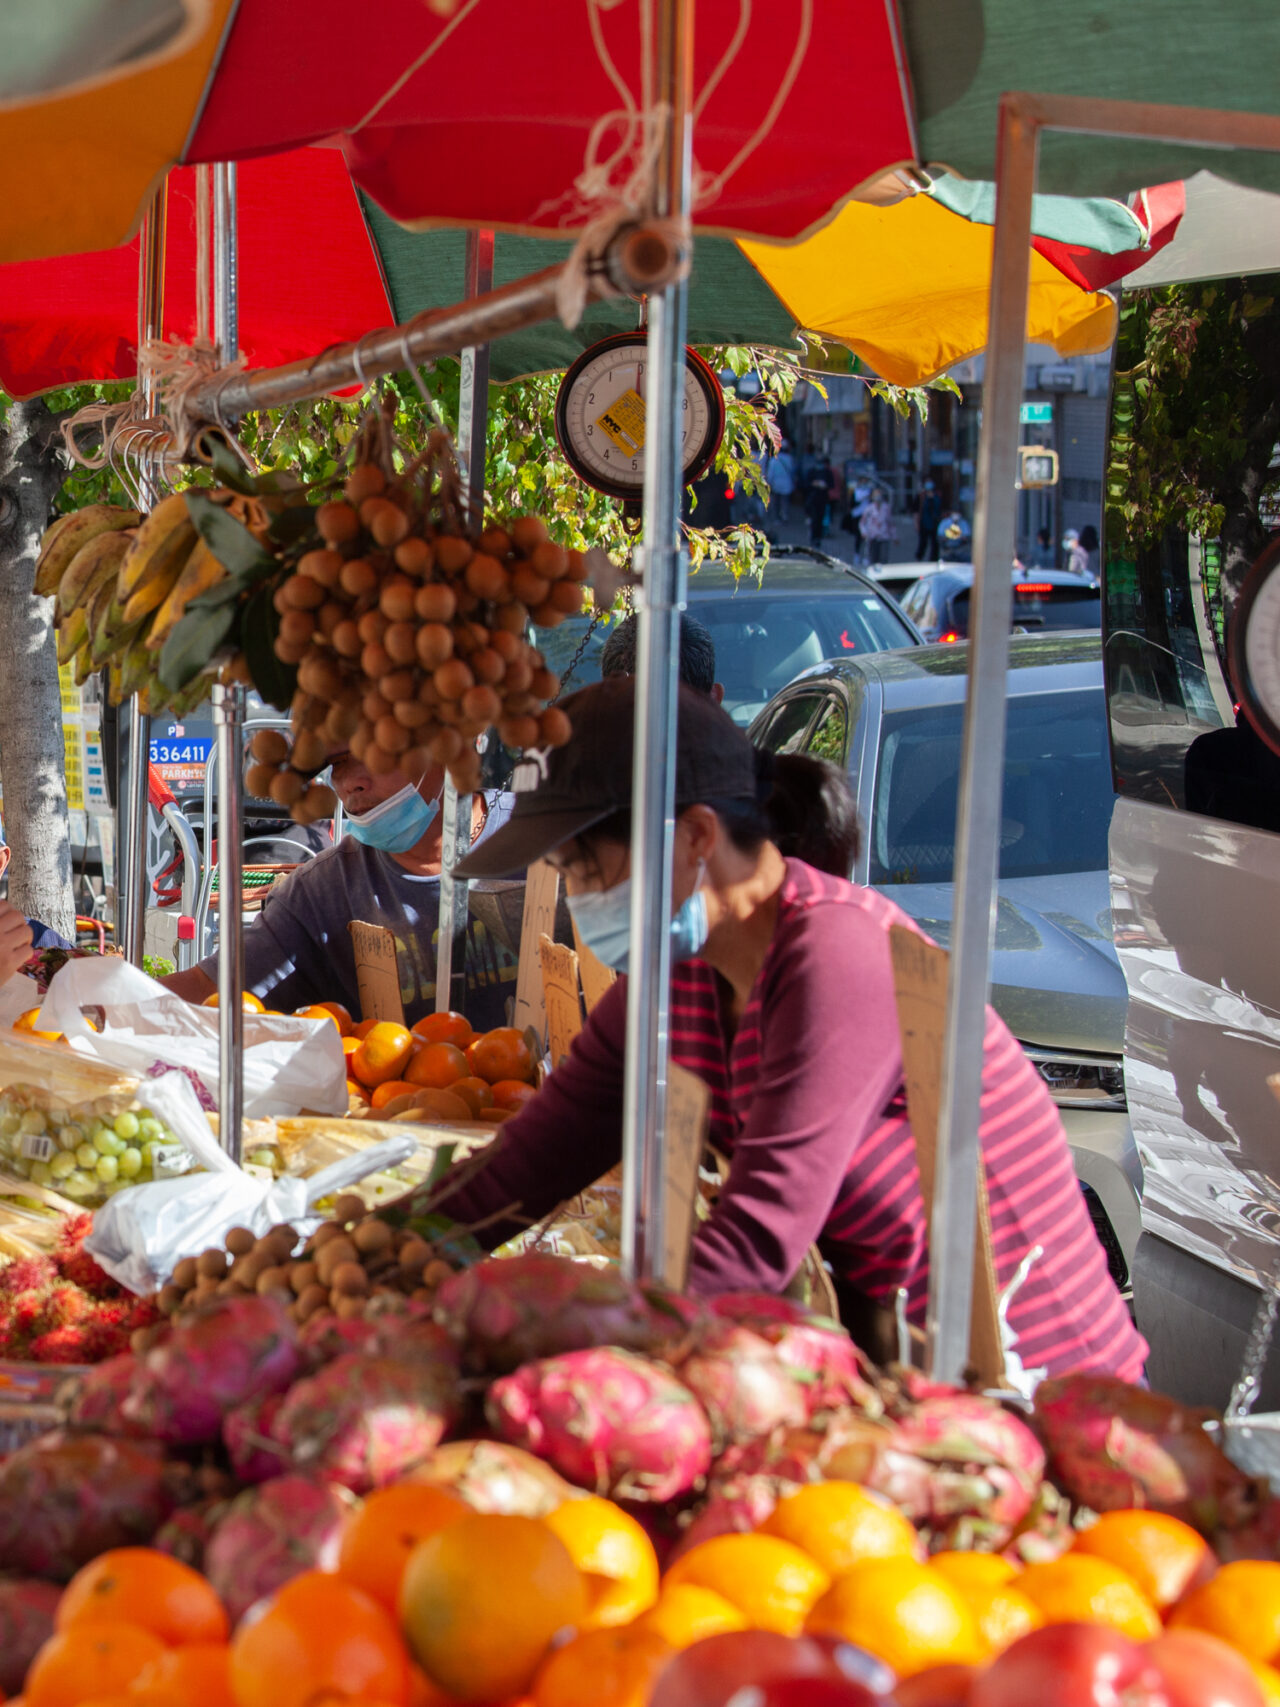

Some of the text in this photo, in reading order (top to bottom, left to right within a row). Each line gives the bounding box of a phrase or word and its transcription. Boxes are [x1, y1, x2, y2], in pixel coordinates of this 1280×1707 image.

[588, 392, 595, 405] 2
[586, 424, 593, 436] 3
[602, 414, 621, 434] NYC
[603, 449, 610, 460] 4
[631, 459, 638, 471] 5
[150, 746, 205, 762] 336411
